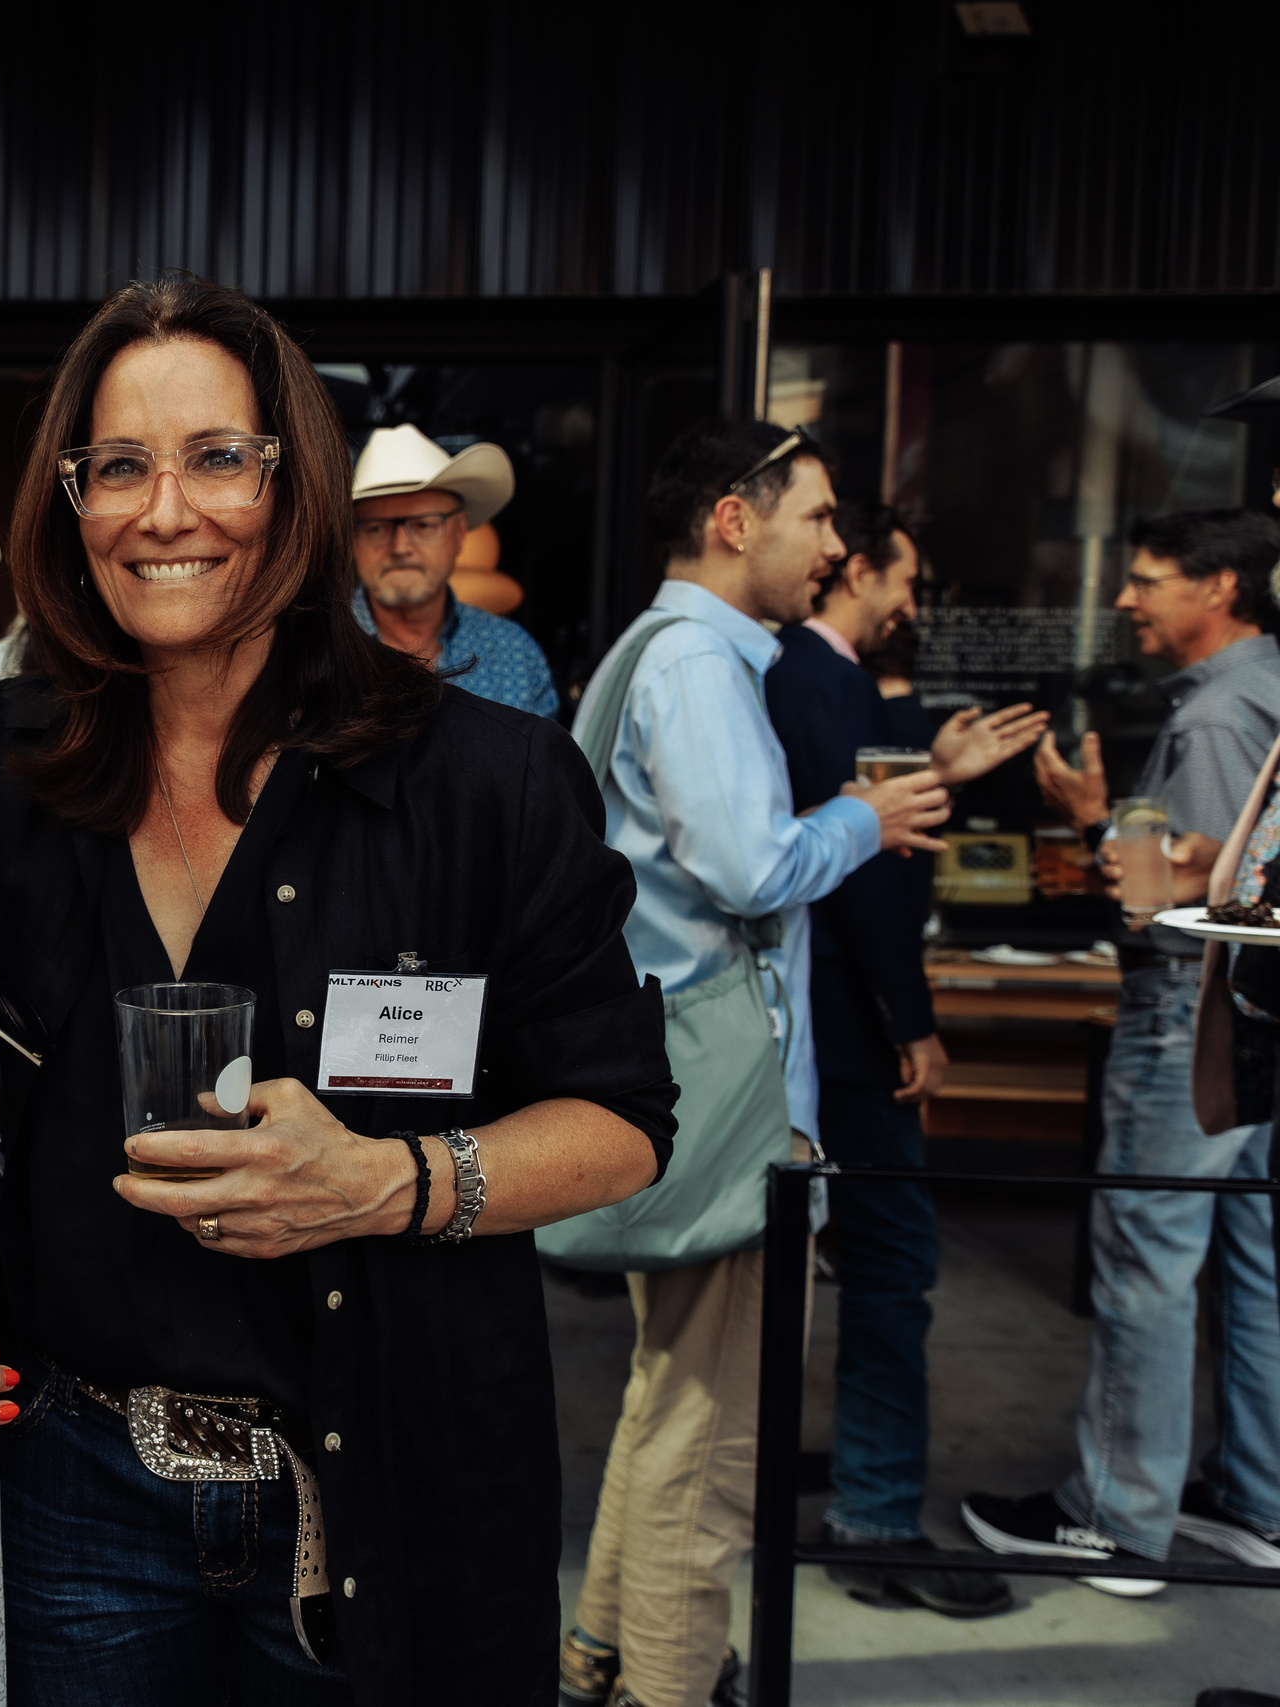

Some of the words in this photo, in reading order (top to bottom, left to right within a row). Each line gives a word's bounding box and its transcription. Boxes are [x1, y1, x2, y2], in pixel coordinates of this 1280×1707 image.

[329, 978, 356, 986] MLT
[357, 978, 402, 988] AIKINS
[378, 1006, 424, 1021] Alice
[378, 1033, 419, 1045] Reimer
[375, 1053, 395, 1063] Fillip
[396, 1054, 418, 1063] Fleet
